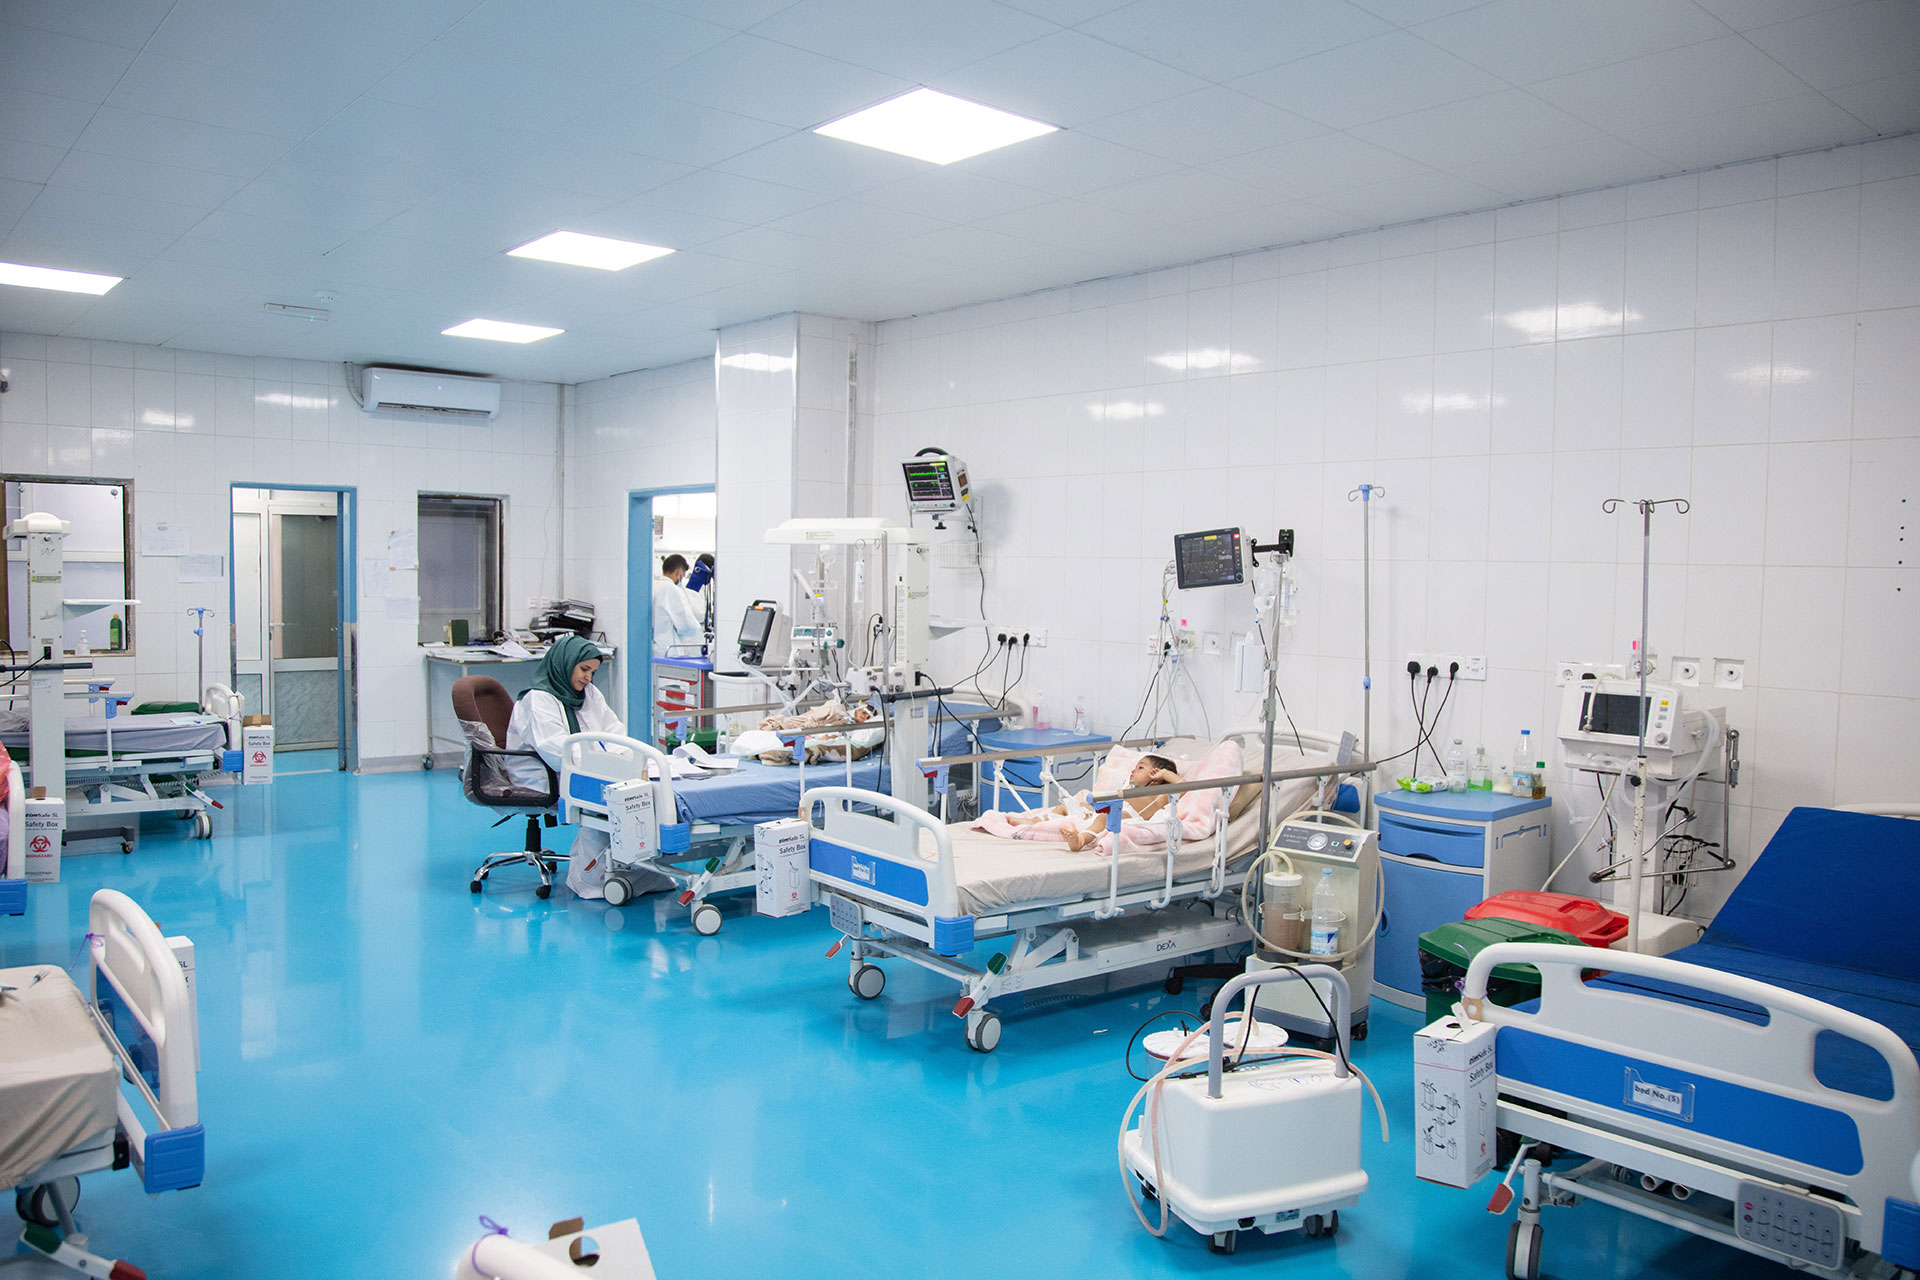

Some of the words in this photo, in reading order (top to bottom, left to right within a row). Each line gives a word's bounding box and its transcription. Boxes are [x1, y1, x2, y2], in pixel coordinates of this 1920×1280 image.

[625, 803, 641, 812] Safety
[25, 821, 45, 829] Safety
[779, 846, 796, 855] Safety
[796, 843, 807, 851] Box
[1156, 940, 1176, 951] DEXA
[1635, 1084, 1650, 1096] bed
